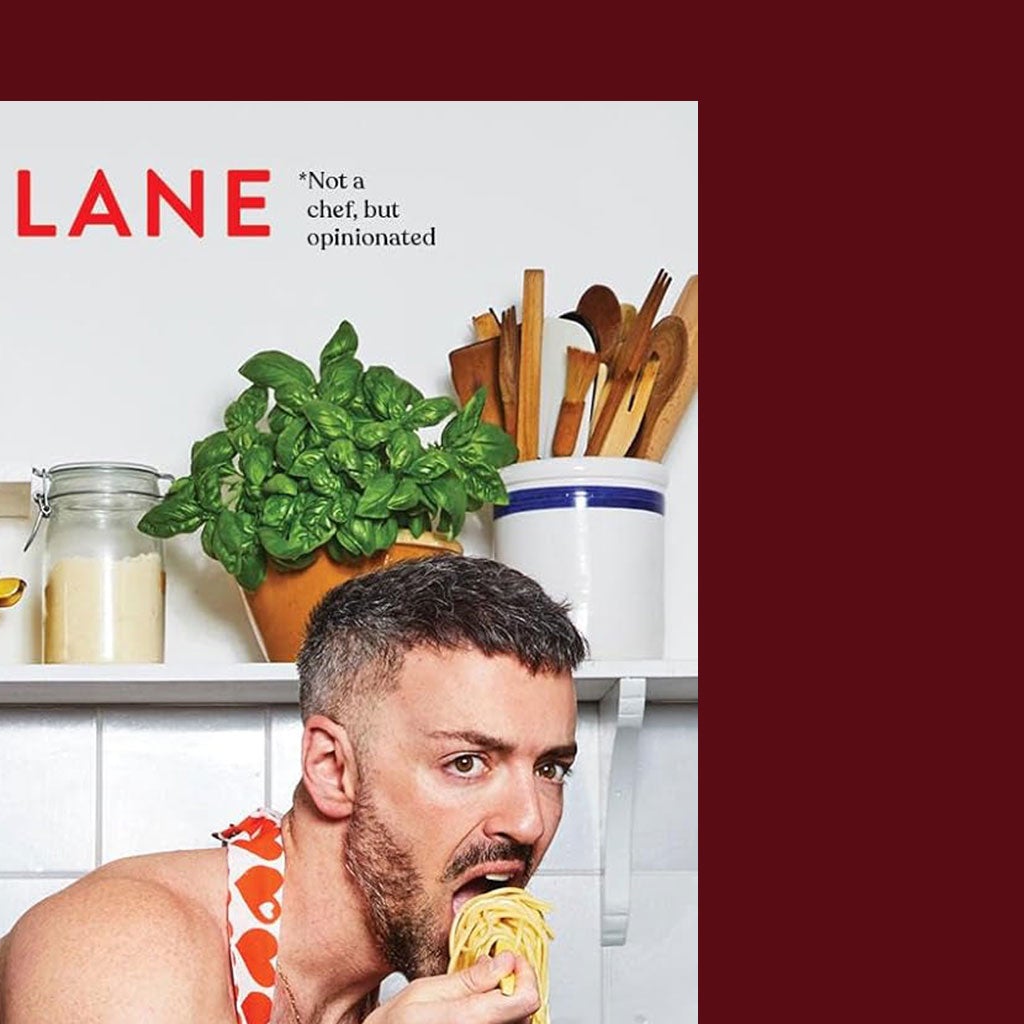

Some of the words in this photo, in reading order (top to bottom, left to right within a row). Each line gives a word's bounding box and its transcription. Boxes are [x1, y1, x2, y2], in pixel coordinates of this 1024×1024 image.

[353, 176, 365, 190] a
[17, 169, 271, 238] LANE
[307, 199, 358, 220] chef,
[364, 199, 400, 218] but
[307, 226, 436, 251] opinionated
